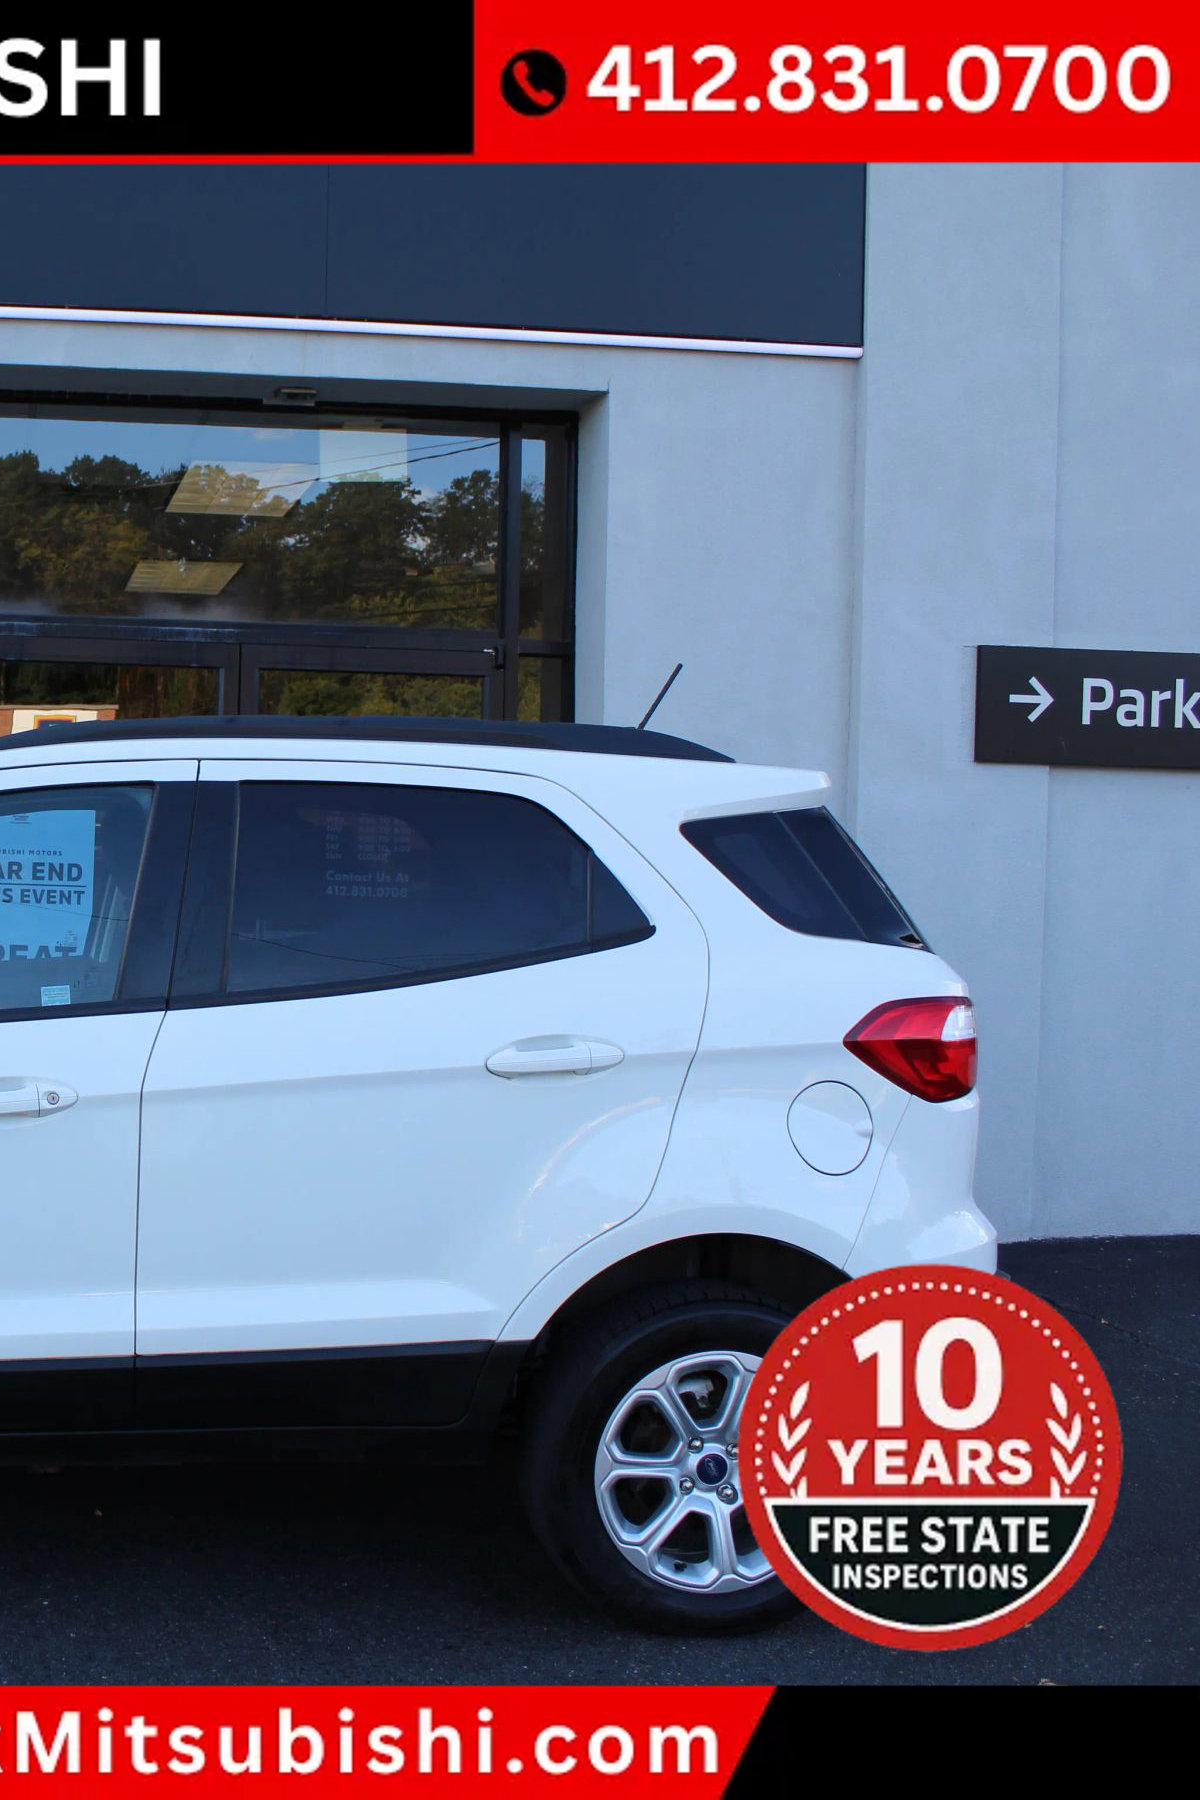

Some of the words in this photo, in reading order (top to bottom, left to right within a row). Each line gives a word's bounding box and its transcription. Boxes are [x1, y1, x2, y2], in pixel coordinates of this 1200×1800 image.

[1082, 678, 1200, 728] Park
[32, 862, 83, 882] END
[20, 888, 85, 905] EVENT
